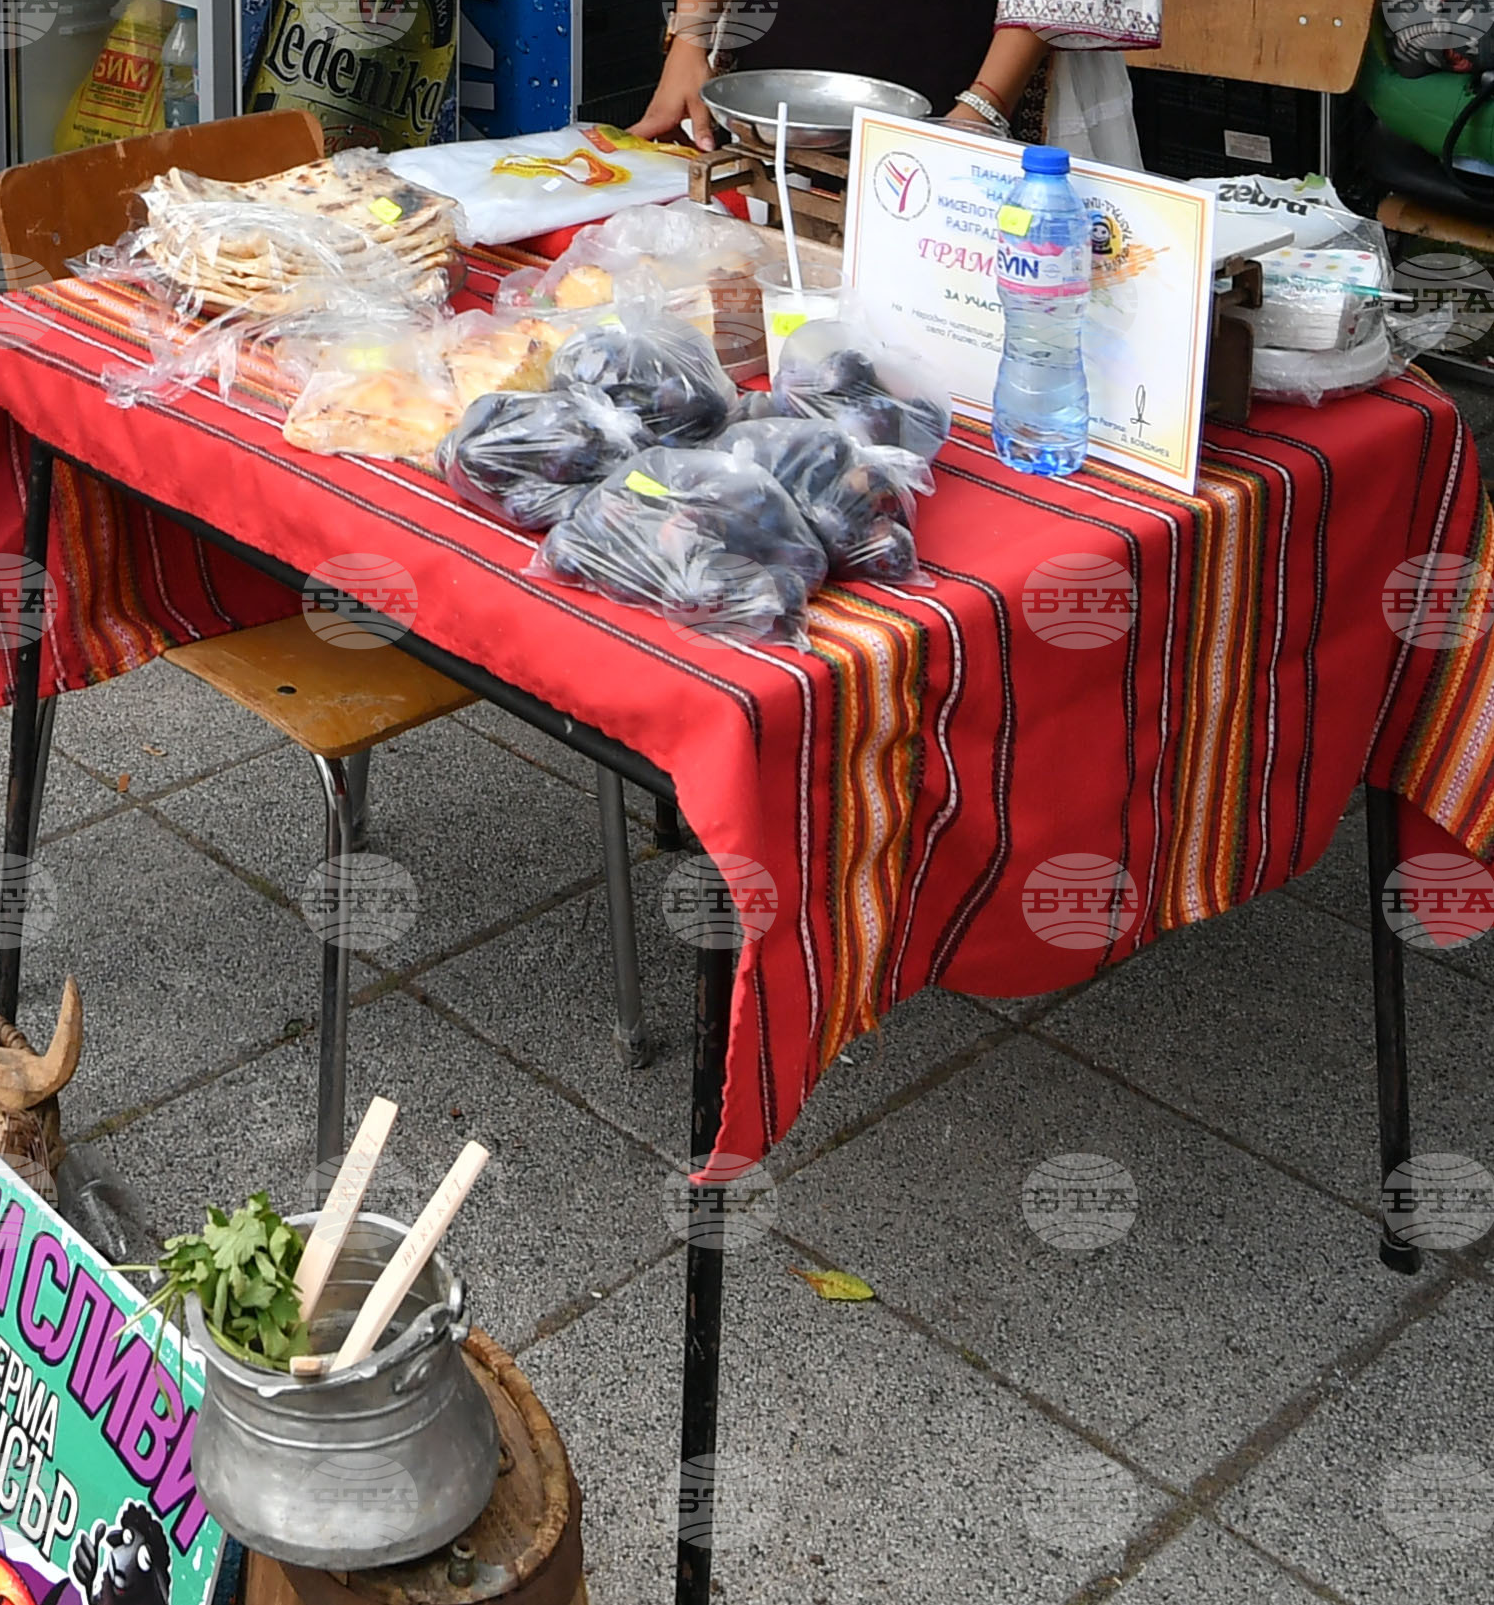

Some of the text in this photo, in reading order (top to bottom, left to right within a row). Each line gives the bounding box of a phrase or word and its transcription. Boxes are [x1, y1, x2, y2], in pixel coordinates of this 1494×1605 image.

[264, 0, 444, 135] Ledenika
[937, 195, 999, 220] КИСЕЛОТ
[1219, 179, 1308, 216] zebra
[918, 237, 997, 277] ГРАМ
[944, 288, 960, 302] ЗА
[17, 1230, 208, 1556] СЛИВИ
